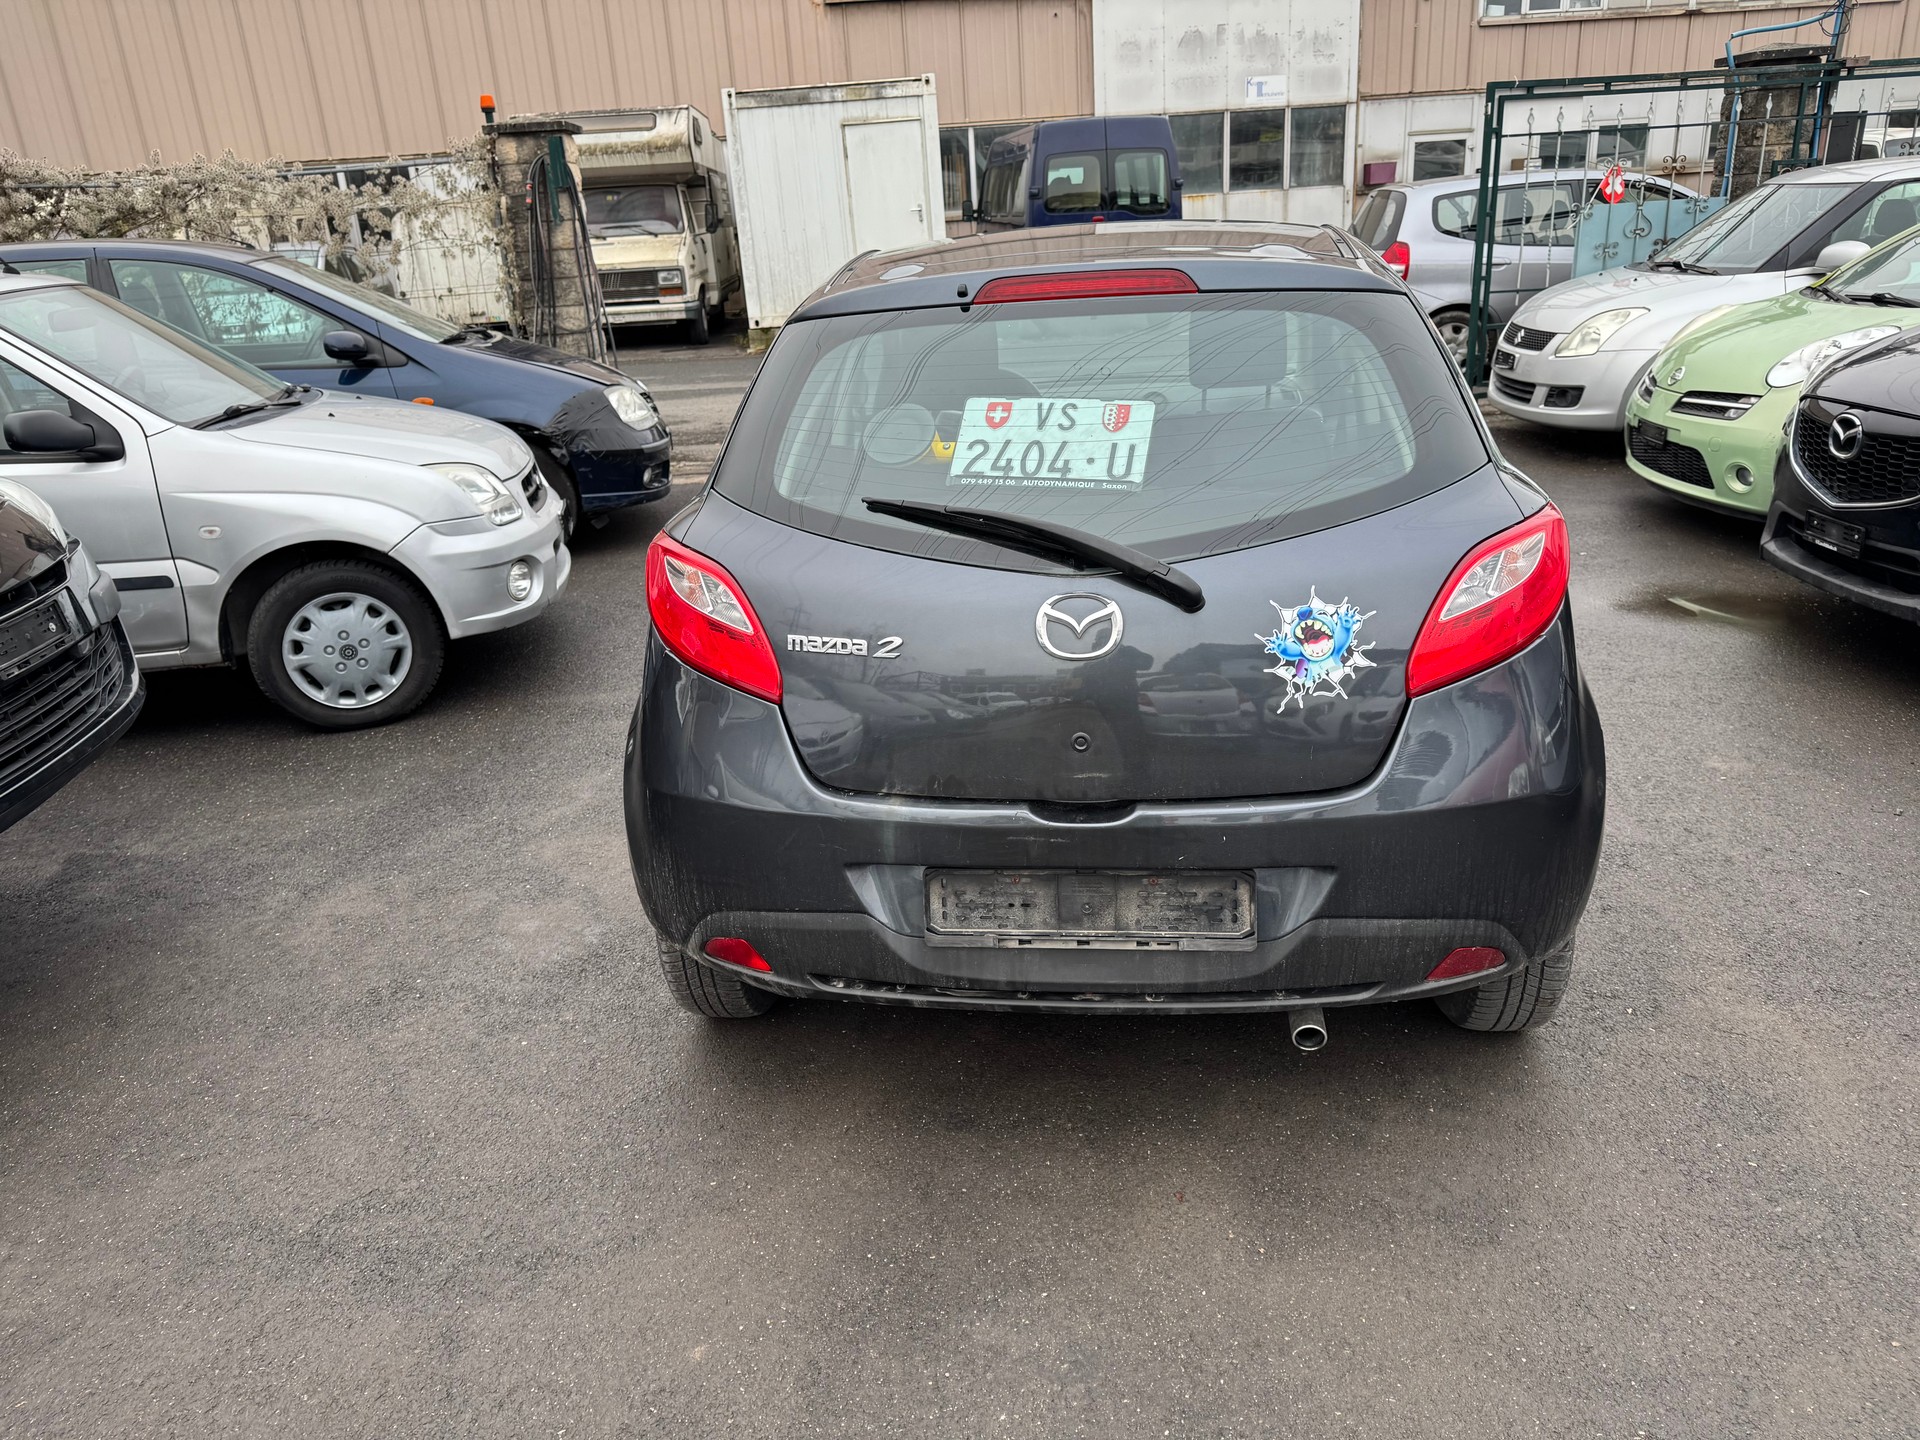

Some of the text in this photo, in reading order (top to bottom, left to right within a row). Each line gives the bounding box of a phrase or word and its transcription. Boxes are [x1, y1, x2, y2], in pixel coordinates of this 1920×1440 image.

[1037, 402, 1078, 431] VS
[1021, 479, 1096, 489] AUTODYNAMIQUE
[1102, 482, 1127, 490] Saxon
[787, 634, 903, 659] mazda 2
